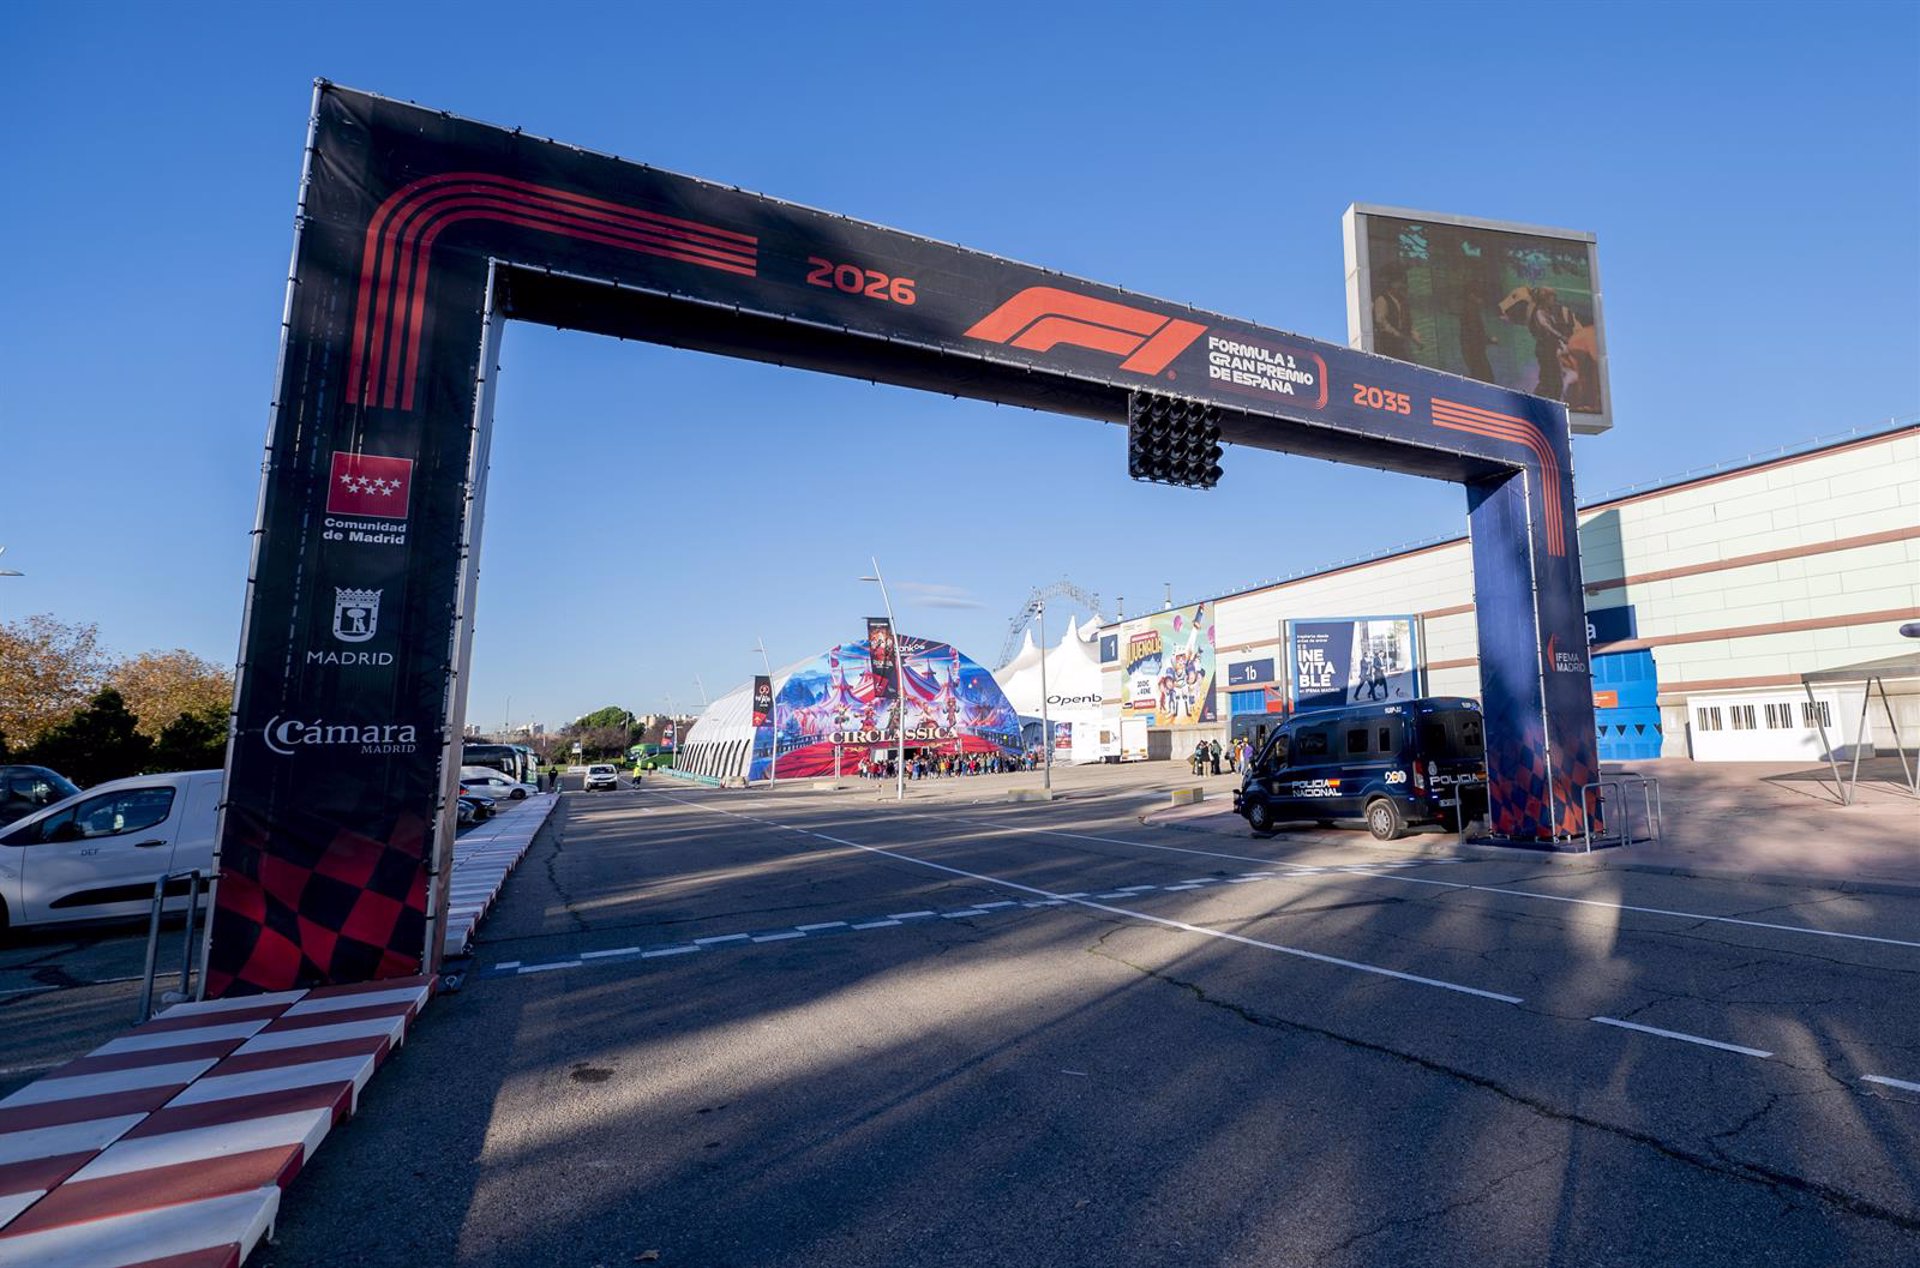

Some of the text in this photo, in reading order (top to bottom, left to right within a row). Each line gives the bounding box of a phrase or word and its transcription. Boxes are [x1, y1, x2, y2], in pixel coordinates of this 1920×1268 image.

[806, 256, 916, 305] 2026
[1209, 336, 1296, 369] FORMULA 1
[1209, 351, 1314, 385] GRAN PREMIO
[1209, 365, 1231, 382] DE
[1353, 383, 1411, 415] 2035
[324, 517, 407, 533] Comunidad
[323, 529, 405, 545] de Madrid
[306, 651, 394, 665] MADRID
[1297, 649, 1325, 662] INE
[1555, 653, 1579, 662] IFEMA
[1245, 665, 1257, 680] 1b
[1298, 661, 1336, 674] VITA
[1556, 663, 1586, 672] MADRID
[1299, 674, 1332, 687] BLE
[1047, 693, 1103, 706] Openb
[270, 718, 417, 749] Cámara
[361, 745, 416, 754] MADRID
[1292, 779, 1330, 788] POLICIA
[1429, 773, 1479, 786] POLICIA
[1293, 788, 1343, 797] NACIONAL
